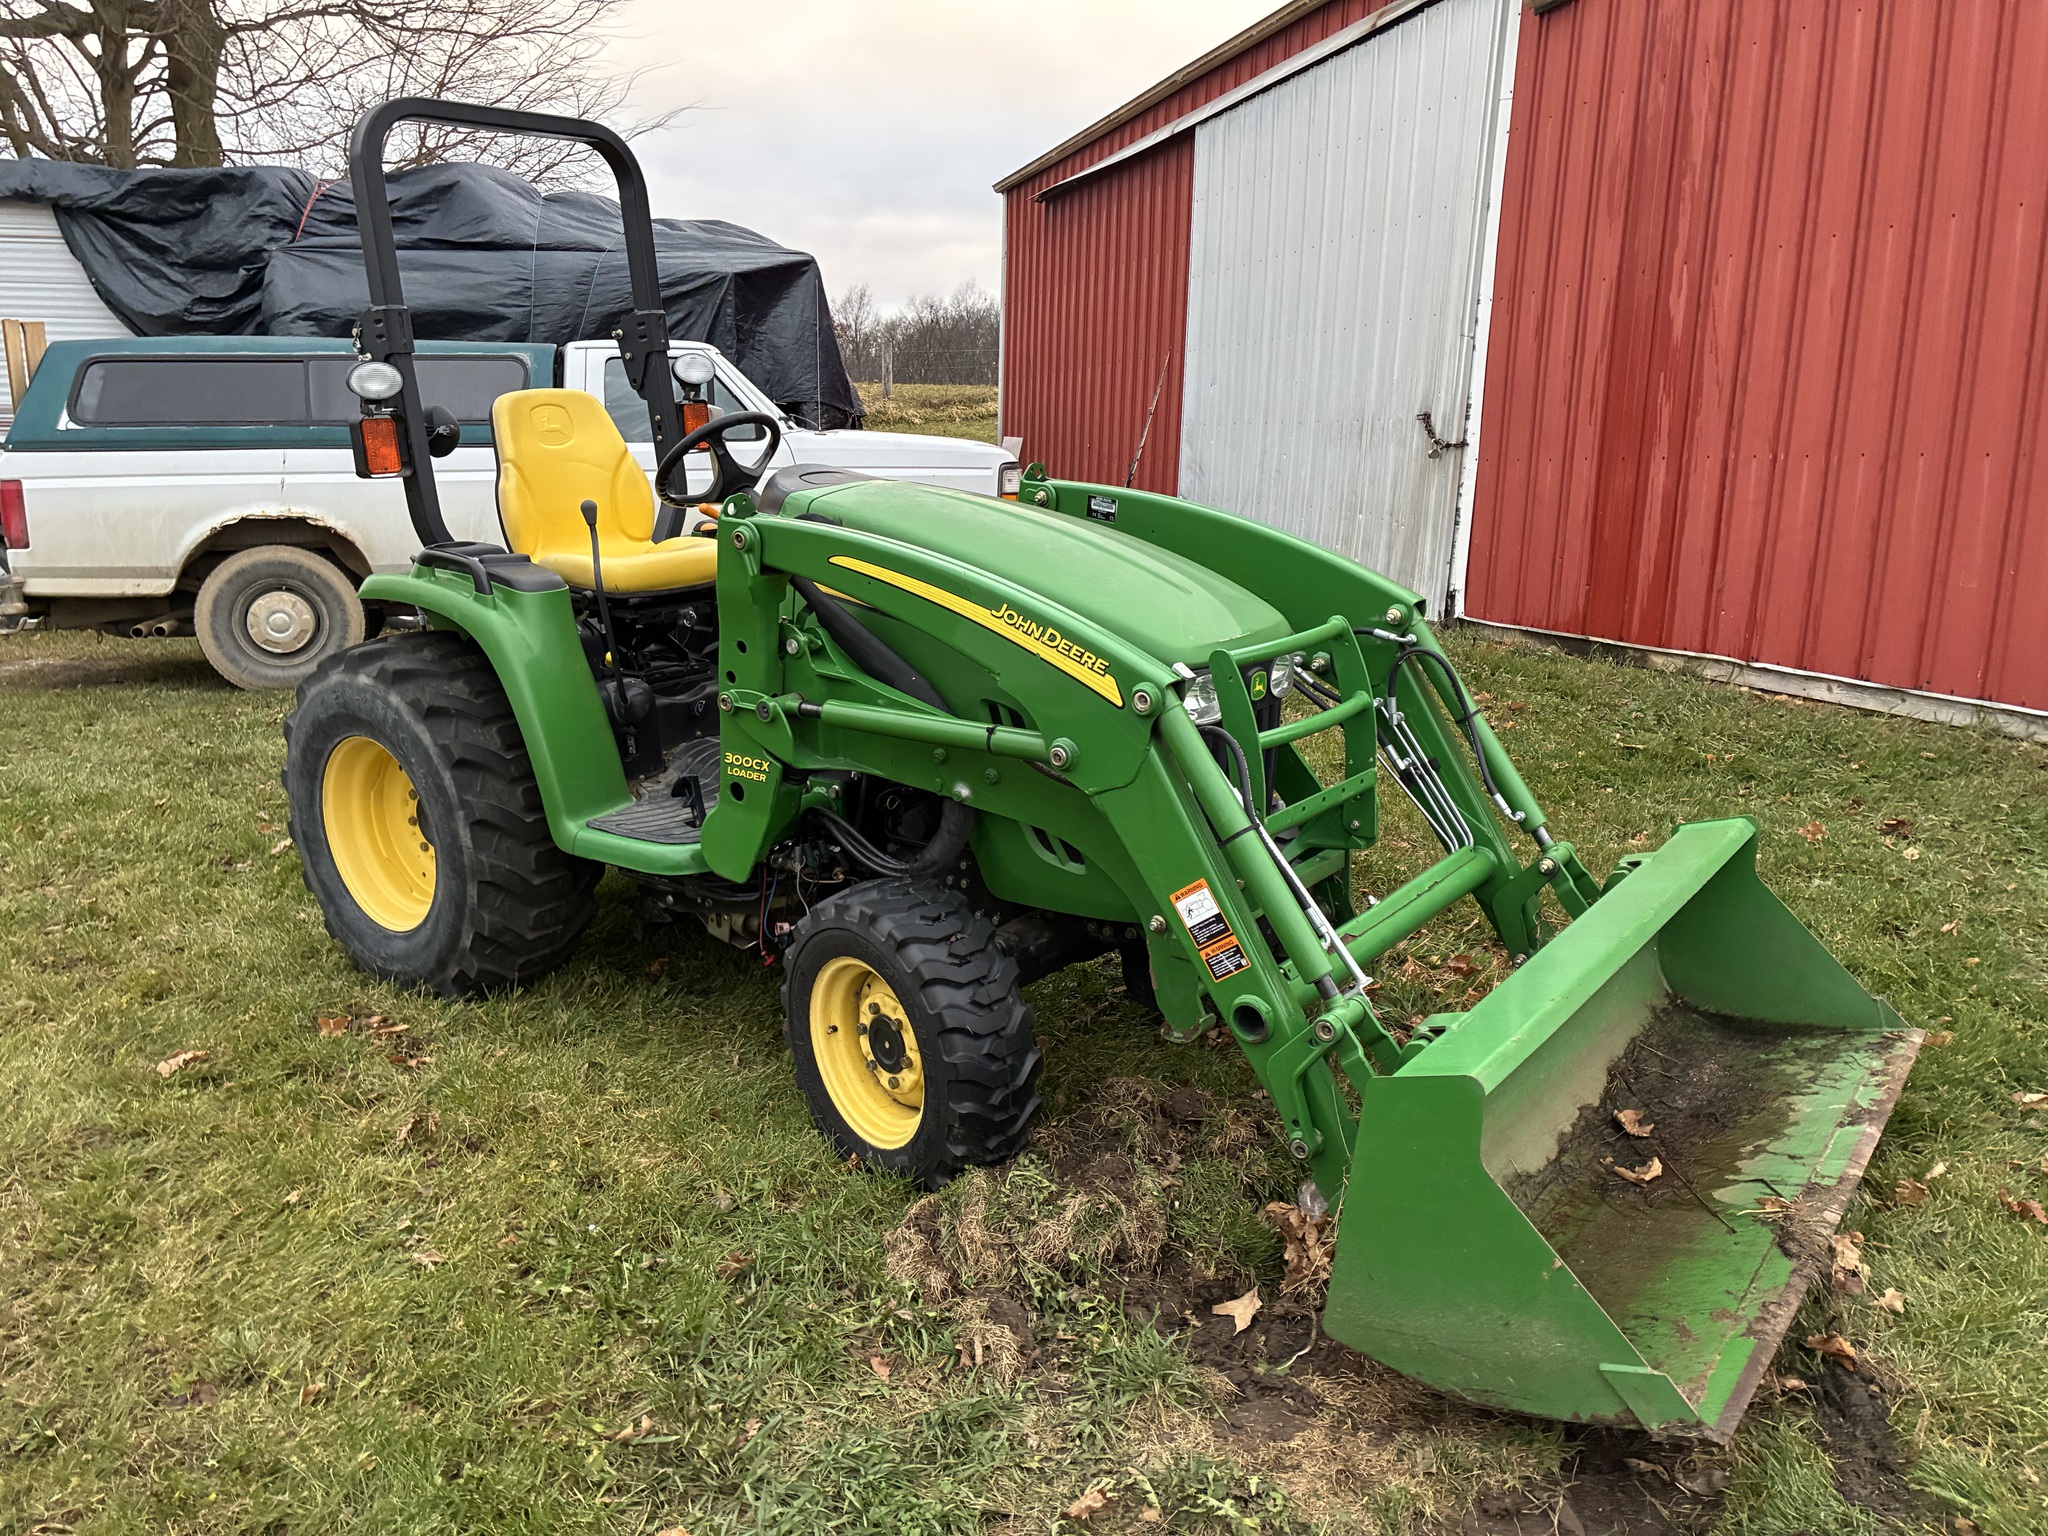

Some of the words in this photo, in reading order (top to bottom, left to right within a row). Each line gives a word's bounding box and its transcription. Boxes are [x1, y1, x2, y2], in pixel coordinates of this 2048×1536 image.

[991, 603, 1044, 640] JOHN
[1041, 627, 1110, 675] DEERE
[724, 752, 771, 772] 300CX
[727, 766, 767, 782] LOADER
[1180, 882, 1203, 898] WARNING
[1210, 939, 1235, 954] WARNING
